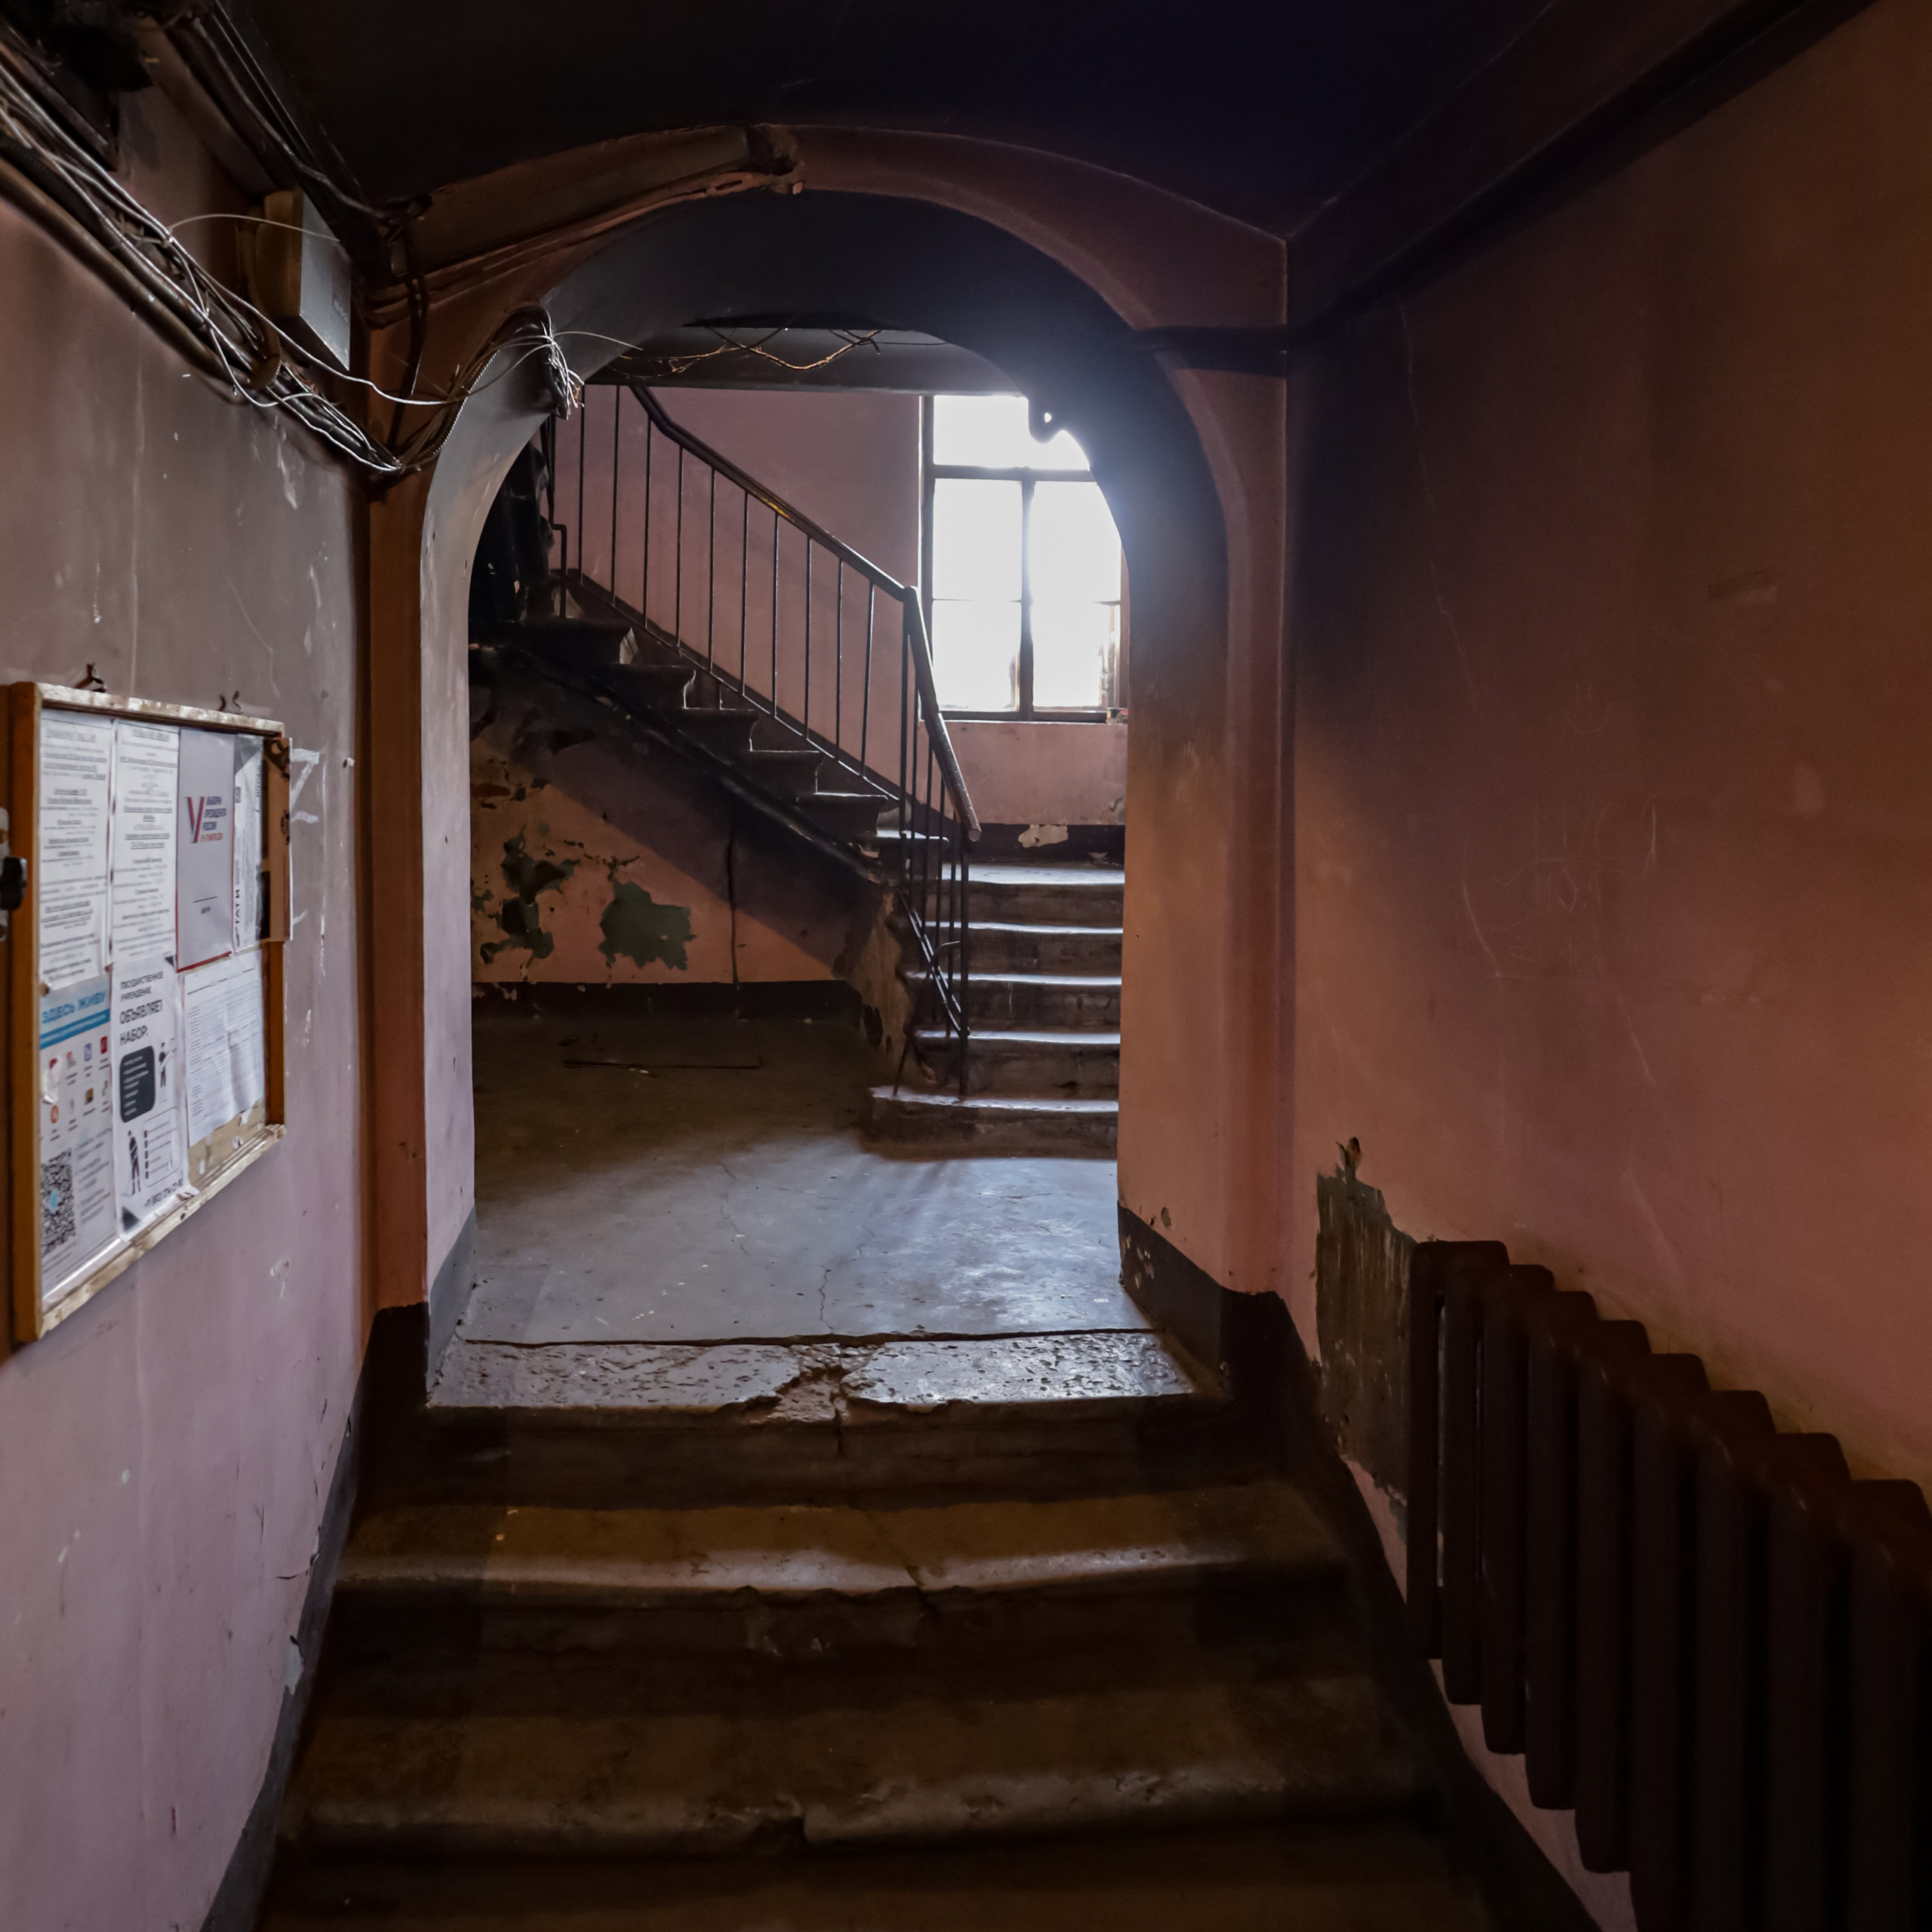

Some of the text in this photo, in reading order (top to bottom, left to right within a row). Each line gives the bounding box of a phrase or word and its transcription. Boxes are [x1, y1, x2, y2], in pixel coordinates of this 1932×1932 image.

[42, 990, 107, 1024] ЗДЕСЬ ЖИВУ
[120, 999, 163, 1024] ОБЪЯВЛЯЕТ
[120, 1025, 149, 1046] НАБОР:
